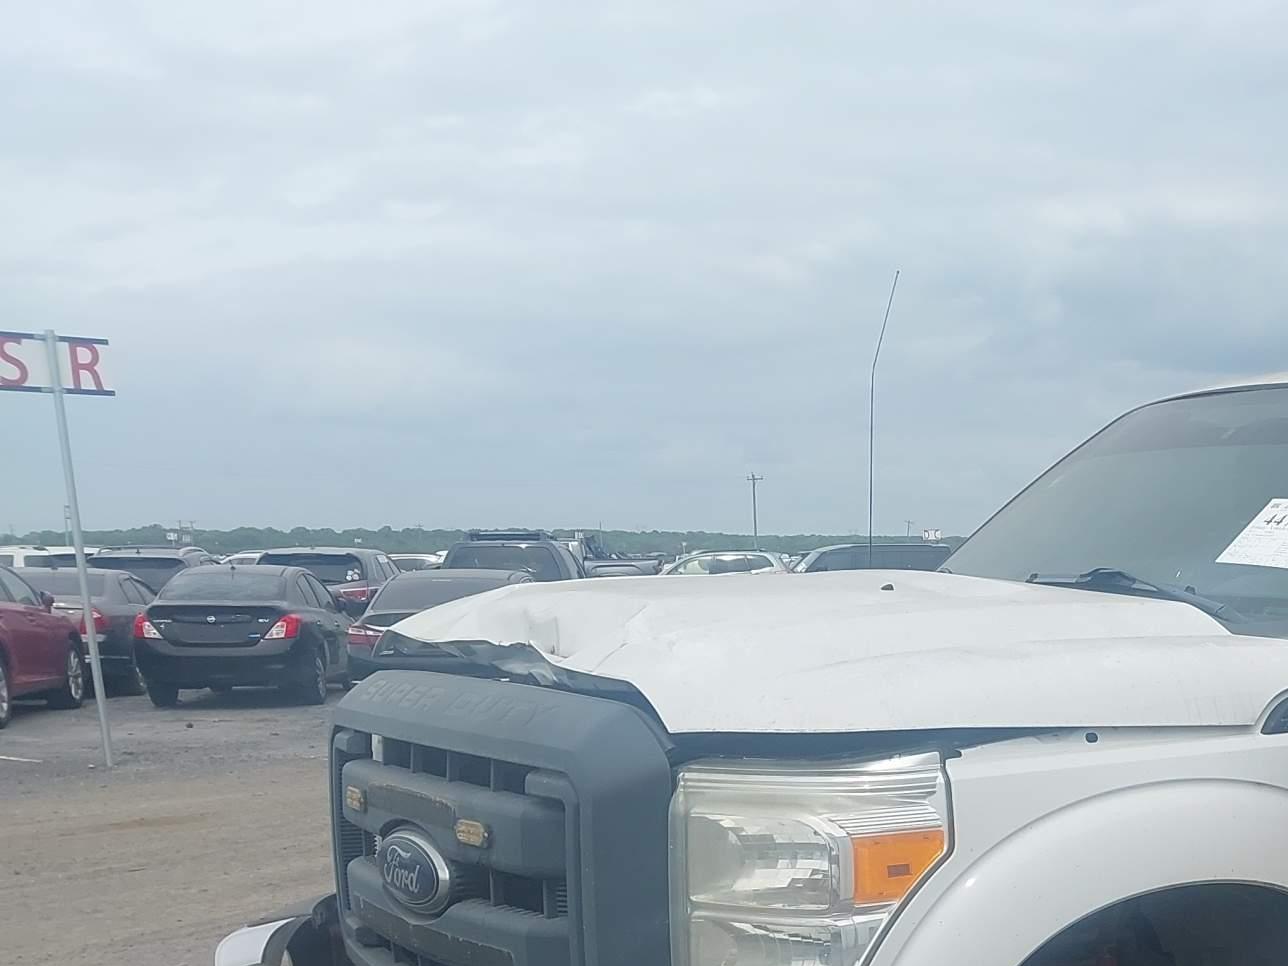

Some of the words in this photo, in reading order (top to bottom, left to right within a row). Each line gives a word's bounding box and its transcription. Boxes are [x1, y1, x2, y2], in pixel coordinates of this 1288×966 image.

[0, 336, 28, 387] S
[69, 341, 104, 391] R
[361, 679, 445, 713] SUPER
[443, 688, 561, 727] DUTY
[383, 845, 421, 893] Ford
